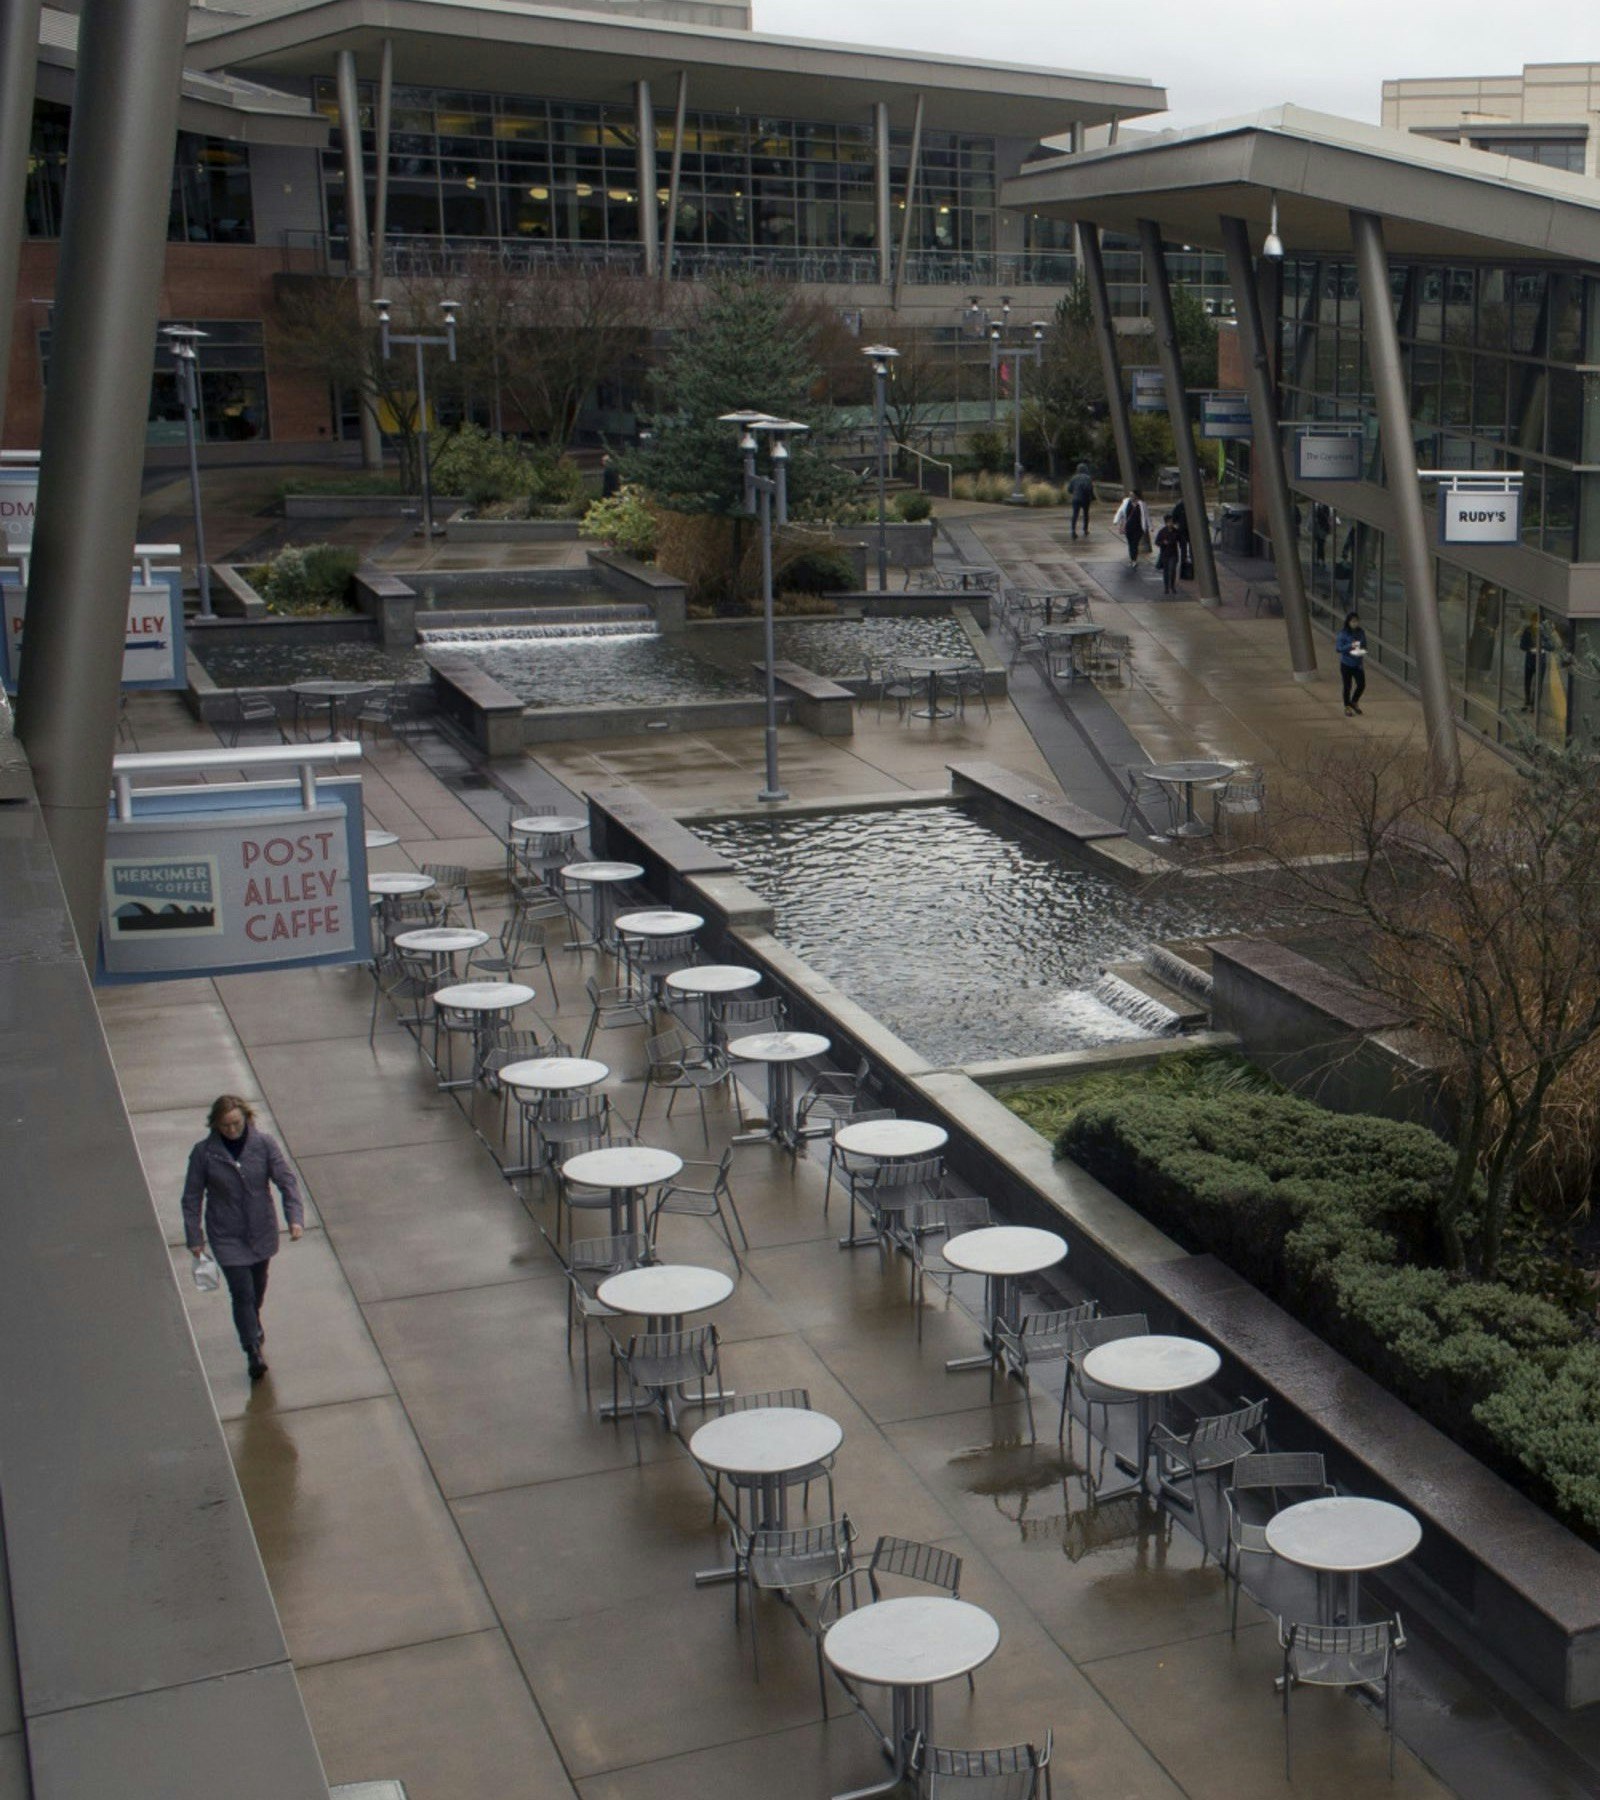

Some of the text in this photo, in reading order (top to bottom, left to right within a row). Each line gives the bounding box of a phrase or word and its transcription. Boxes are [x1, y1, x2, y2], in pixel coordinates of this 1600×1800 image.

[1458, 511, 1506, 523] RUDY'S
[241, 832, 333, 869] POST
[115, 866, 208, 883] HERKIMER
[155, 881, 209, 893] COFFEE
[244, 869, 337, 906] ALLEY
[245, 905, 340, 942] CAFFE
